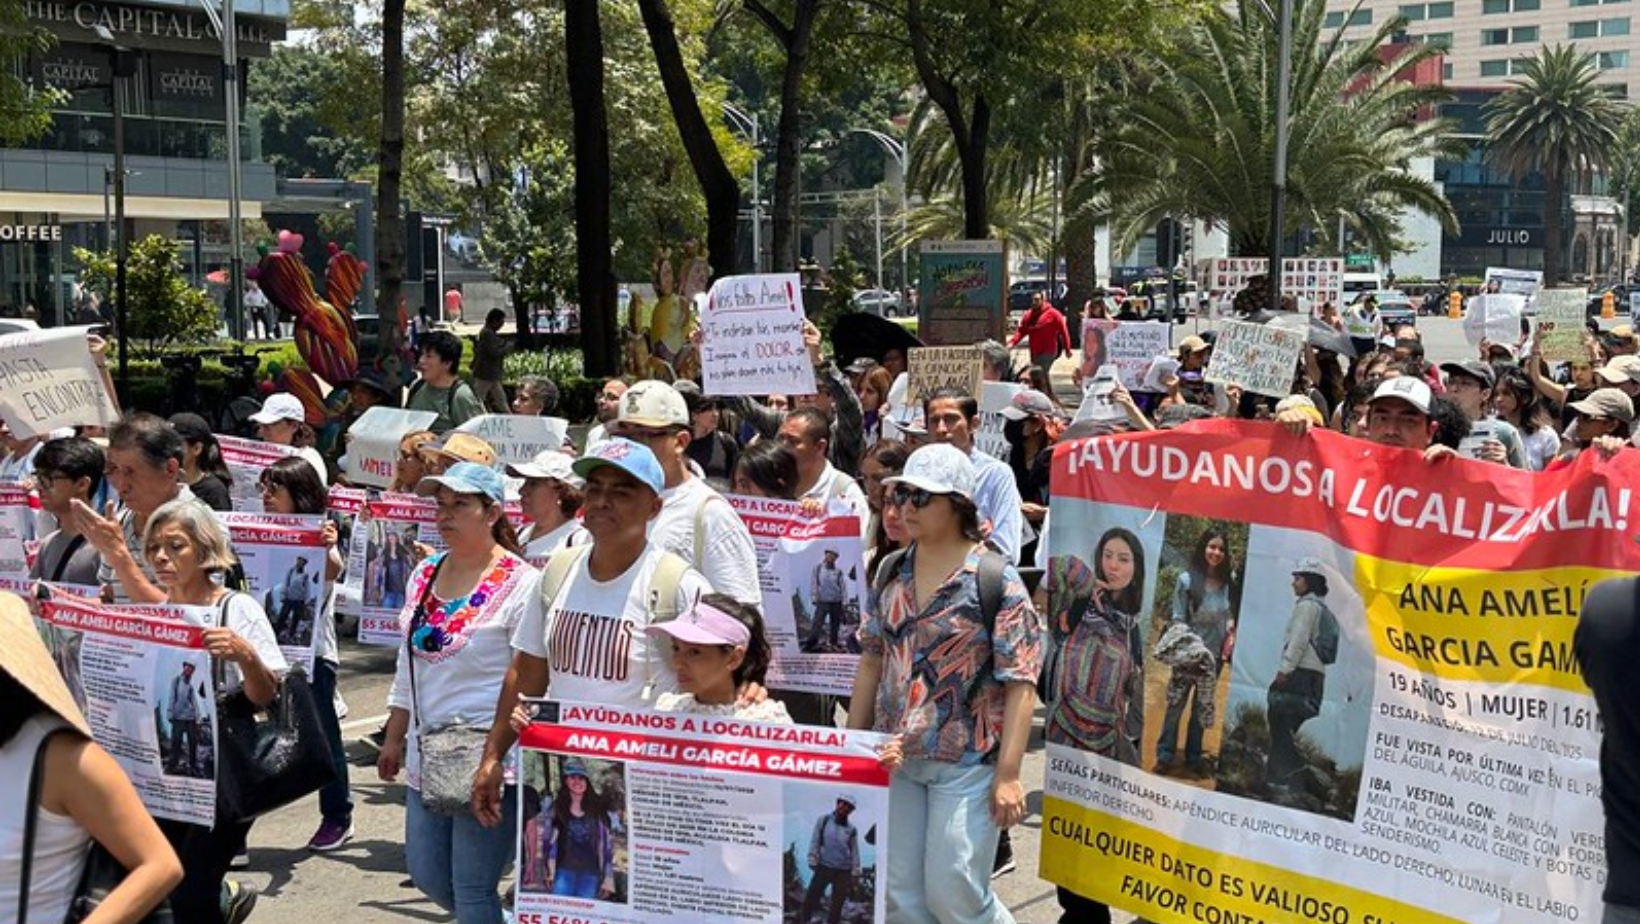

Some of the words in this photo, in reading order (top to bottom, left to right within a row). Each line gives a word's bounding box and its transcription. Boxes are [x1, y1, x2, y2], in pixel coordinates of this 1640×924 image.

[74, 1, 202, 40] CAPITAL
[1487, 230, 1530, 244] JULIO
[755, 341, 794, 358] DOLOR
[1068, 437, 1313, 496] ¡AYUDANOS
[1318, 468, 1335, 507] A
[1398, 583, 1469, 616] ANA
[53, 609, 78, 622] ANA
[80, 613, 114, 629] AMELI
[114, 618, 153, 636] GARCÍA
[154, 624, 190, 641] GÁMEZ
[551, 609, 634, 681] JUVENTUS
[1386, 627, 1505, 667] GARCIA
[1510, 640, 1577, 674] GAM
[1389, 671, 1407, 691] 19
[1411, 674, 1457, 709] AÑOS
[1481, 694, 1547, 721] MUJER
[1563, 705, 1591, 731] 1.61
[562, 705, 676, 730] ¡AYÚDANOS
[682, 714, 697, 732] A
[703, 715, 847, 747] LOCALIZARLA!
[1508, 731, 1539, 749] JULIO
[565, 733, 610, 751] ANA
[614, 739, 676, 760] AMELI
[682, 743, 761, 769] GARCÍA
[766, 752, 842, 777] GÁMEZ
[1374, 747, 1397, 763] DEL
[1500, 777, 1530, 796] CDMX
[1376, 731, 1400, 748] FUE
[1407, 738, 1441, 759] VISTA
[1448, 748, 1474, 766] POR
[1479, 753, 1523, 779] ÚLTIMA
[1549, 768, 1562, 789] EN
[1567, 778, 1580, 794] EL
[1050, 779, 1101, 804] INFERIOR
[1102, 792, 1154, 822] DERECHO
[1369, 777, 1391, 792] IBA
[1406, 785, 1455, 809] VESTIDA
[1467, 801, 1496, 821] CON:
[1507, 811, 1558, 840] PANTALÓN
[1571, 830, 1605, 850] VERD
[1051, 757, 1089, 779] SEÑAS
[1090, 768, 1171, 808] PARTICULARES:
[1172, 797, 1237, 828] APÉNDICE
[1240, 815, 1321, 849] AURICULAR
[1324, 830, 1349, 855] DEL
[1353, 843, 1391, 864] LADO
[1394, 851, 1456, 886] DERECHO,
[1516, 892, 1533, 909] EL
[1536, 896, 1579, 922] LABIO
[1405, 816, 1457, 843] MOCHILA
[1460, 833, 1488, 853] AZUL
[1491, 842, 1530, 866] CELESTE
[1533, 855, 1541, 868] Y
[1547, 858, 1592, 880] BOTAS
[1425, 806, 1488, 835] CHAMARRA
[1492, 826, 1528, 848] BLANCA
[1533, 838, 1560, 857] CON
[1049, 815, 1155, 867] CUALQUIER
[1160, 852, 1213, 888] DATO
[1219, 873, 1243, 898] ES
[1121, 875, 1188, 914] FAVOR
